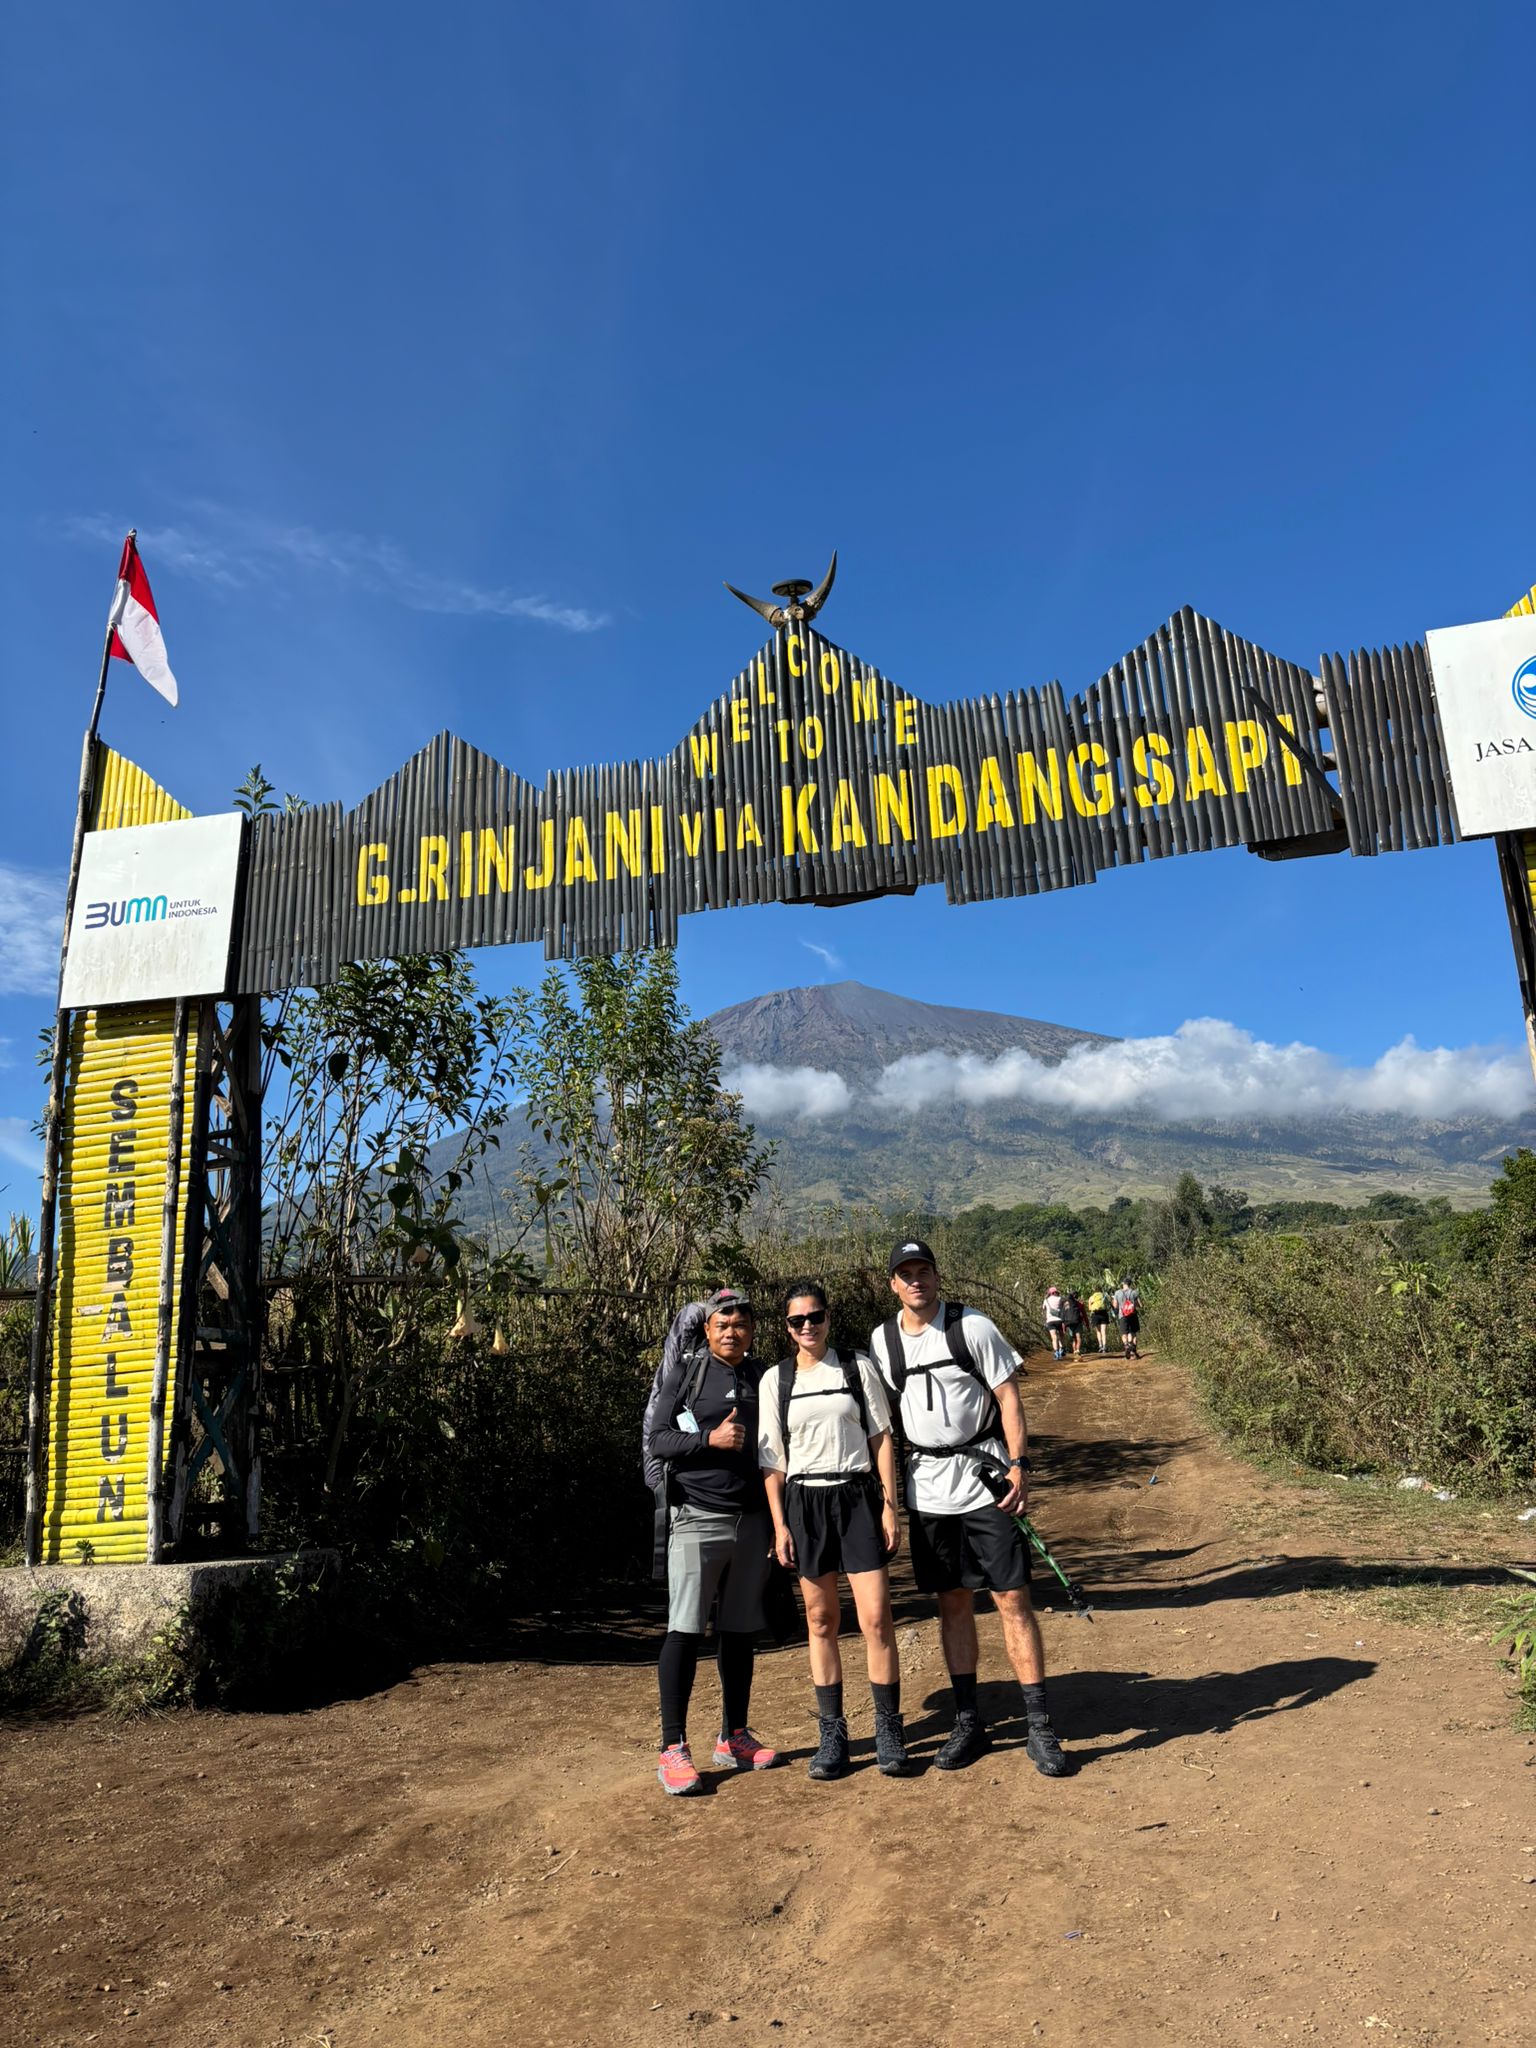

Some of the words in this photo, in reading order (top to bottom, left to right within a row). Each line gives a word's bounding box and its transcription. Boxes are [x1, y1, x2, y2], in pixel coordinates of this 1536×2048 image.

[690, 634, 919, 778] WELCOME
[774, 715, 824, 763] TO
[1475, 737, 1534, 762] JASA
[681, 803, 763, 857] VIA
[168, 906, 218, 918] INDONESIA
[170, 899, 201, 909] UNTUK
[97, 1080, 139, 1523] SEMBALUN
